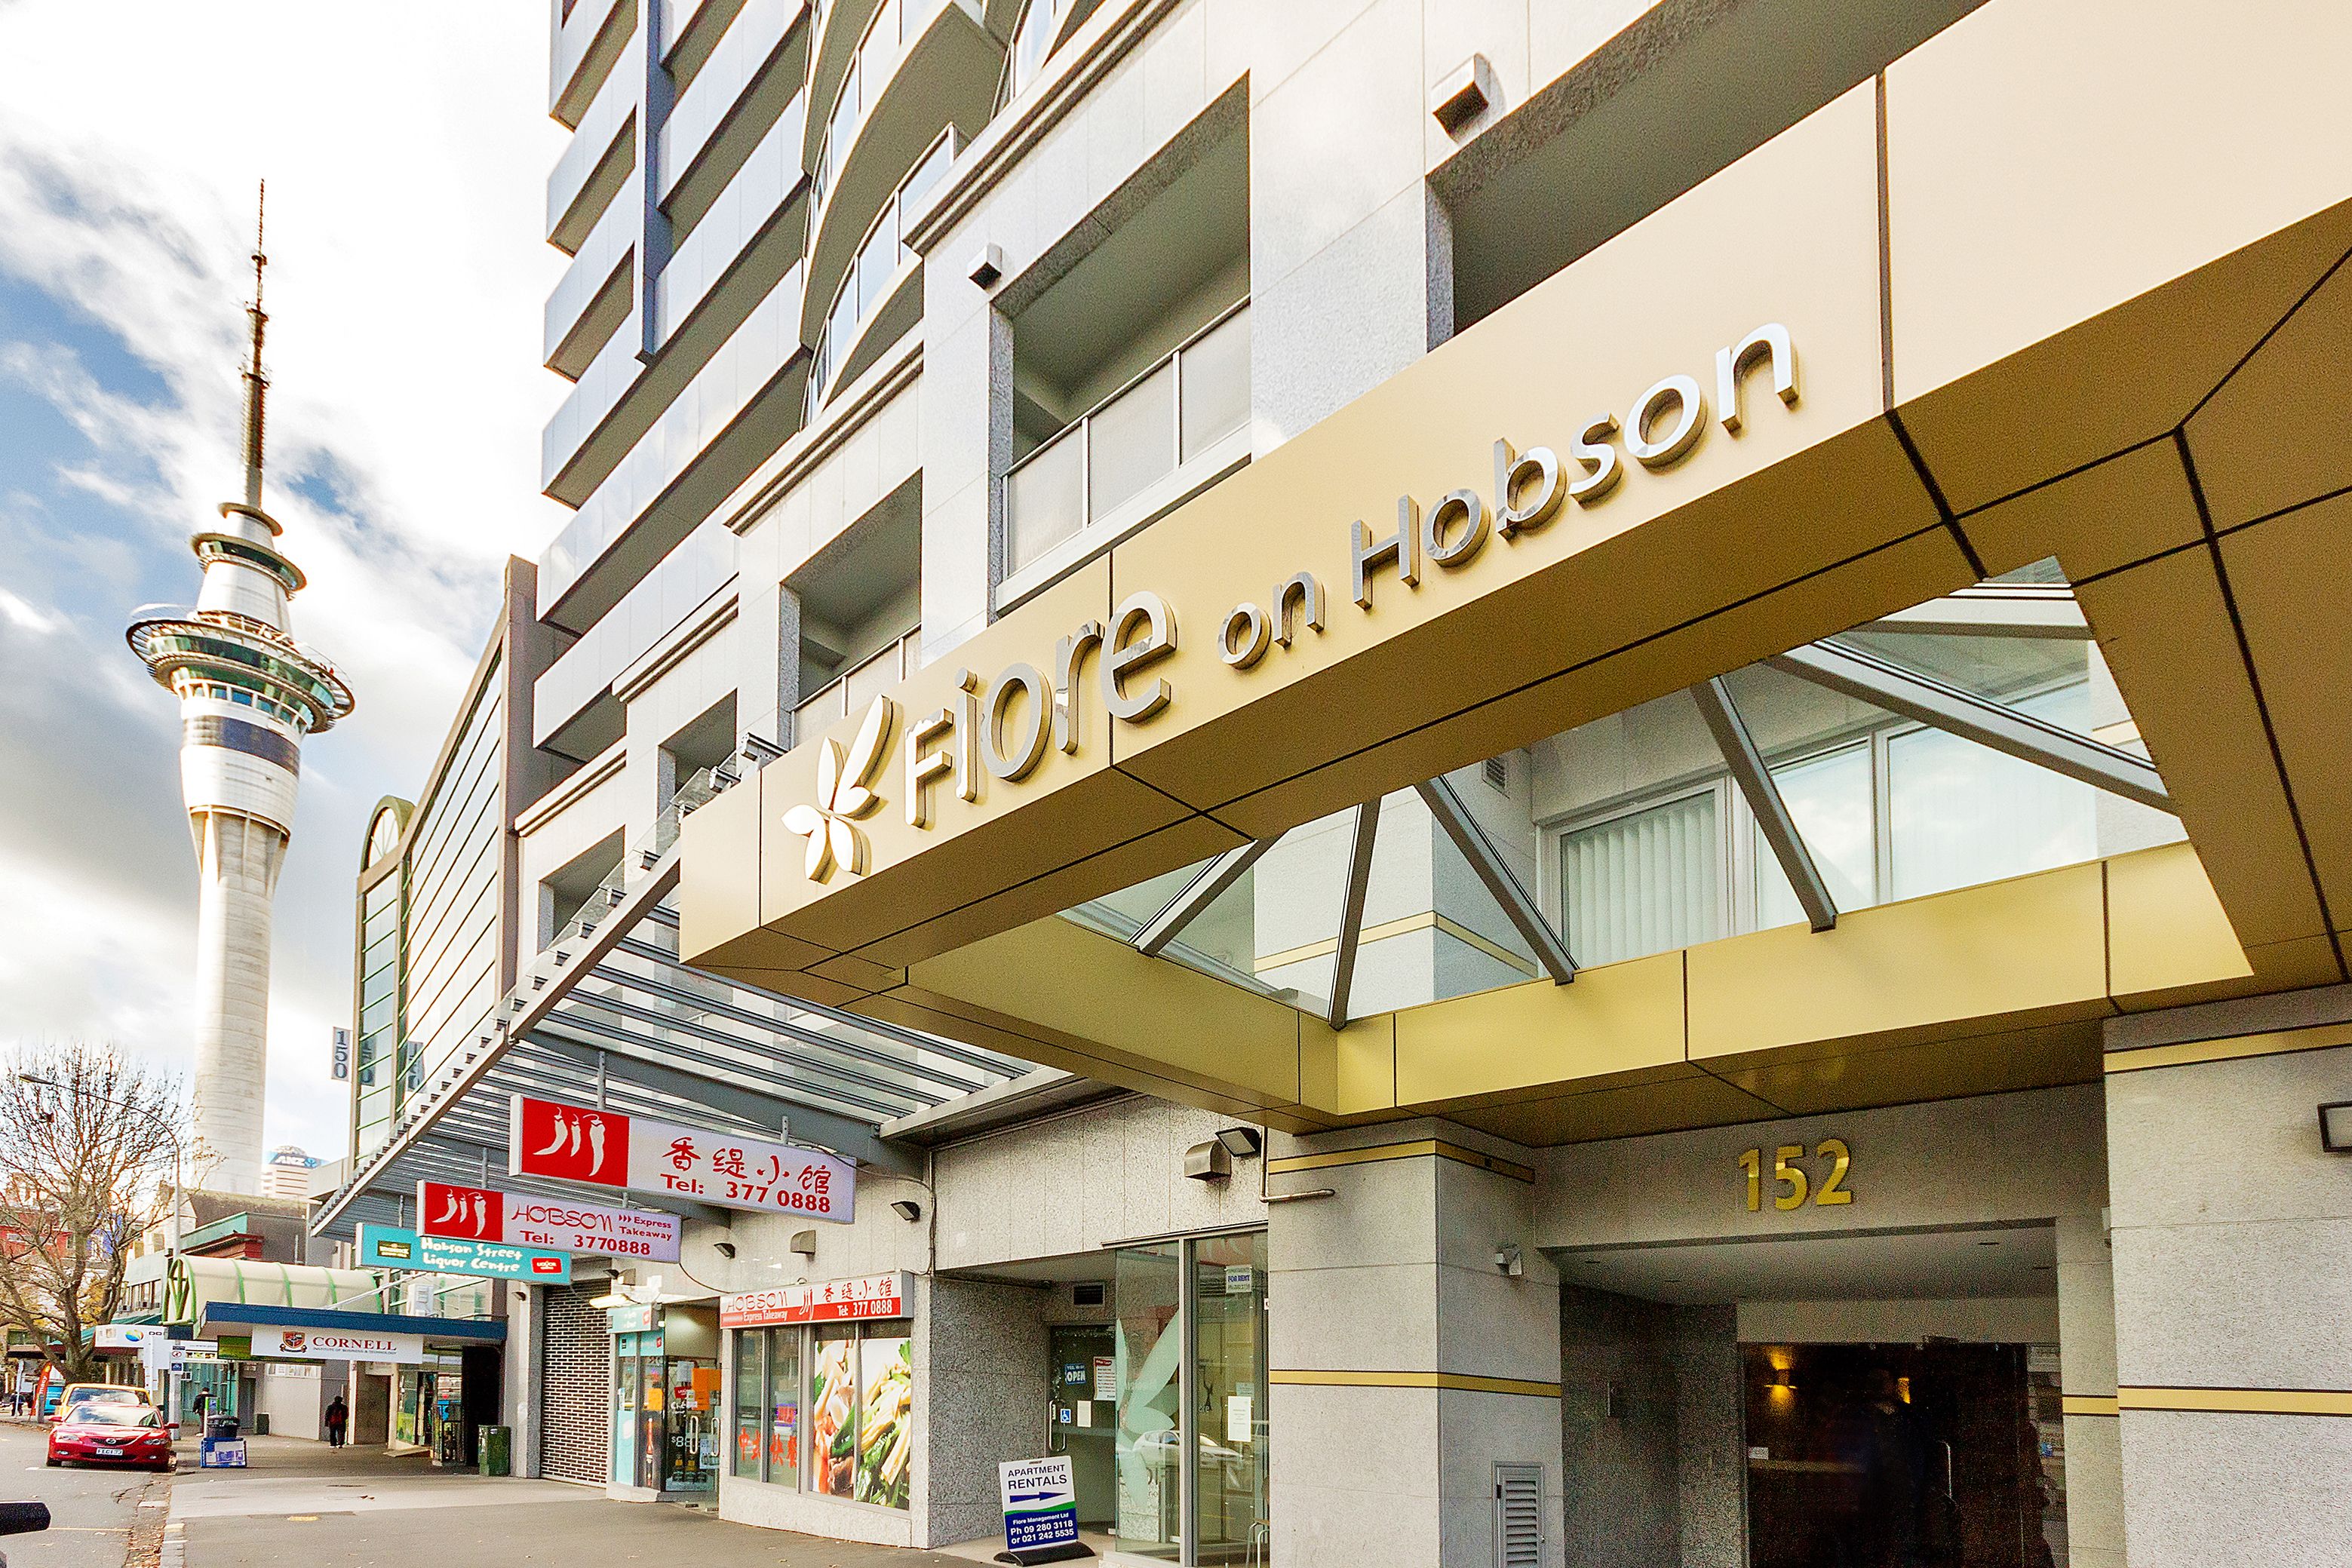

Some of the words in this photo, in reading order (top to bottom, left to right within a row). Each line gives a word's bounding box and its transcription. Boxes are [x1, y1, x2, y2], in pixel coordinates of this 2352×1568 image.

[905, 591, 1178, 828] Fiore
[1217, 570, 1325, 670] on
[1351, 322, 1800, 612] Hobson
[334, 1030, 348, 1079] 150
[275, 1155, 306, 1168] ANZ
[1738, 1138, 1853, 1212] 152
[660, 1173, 705, 1192] Tel:
[725, 1180, 769, 1201] 377
[777, 1190, 831, 1213] 0888
[511, 1202, 613, 1232] HOBSON
[634, 1216, 673, 1229] Express
[619, 1226, 673, 1241] Takeaway
[420, 1237, 473, 1254] Hobson
[477, 1243, 524, 1261] Street
[519, 1230, 555, 1245] Tel:
[573, 1234, 652, 1256] 3770888
[422, 1252, 466, 1269] Liquor
[471, 1257, 520, 1273] Centre
[726, 1290, 788, 1312] HOBSON
[852, 1301, 868, 1316] 377
[870, 1299, 893, 1315] 0888
[743, 1311, 763, 1322] Express
[312, 1336, 398, 1351] CORNELL
[1067, 1370, 1086, 1382] OPEN
[1008, 1464, 1065, 1477] APARTMENT
[1008, 1474, 1067, 1490] RENTALS
[1027, 1513, 1060, 1523] Management
[1010, 1527, 1022, 1536] Ph
[1024, 1525, 1035, 1534] 09
[1036, 1523, 1052, 1532] 280
[1053, 1520, 1073, 1529] 3118
[1021, 1534, 1036, 1542] 021
[1038, 1531, 1054, 1540] 242
[1055, 1528, 1074, 1538] 5535
